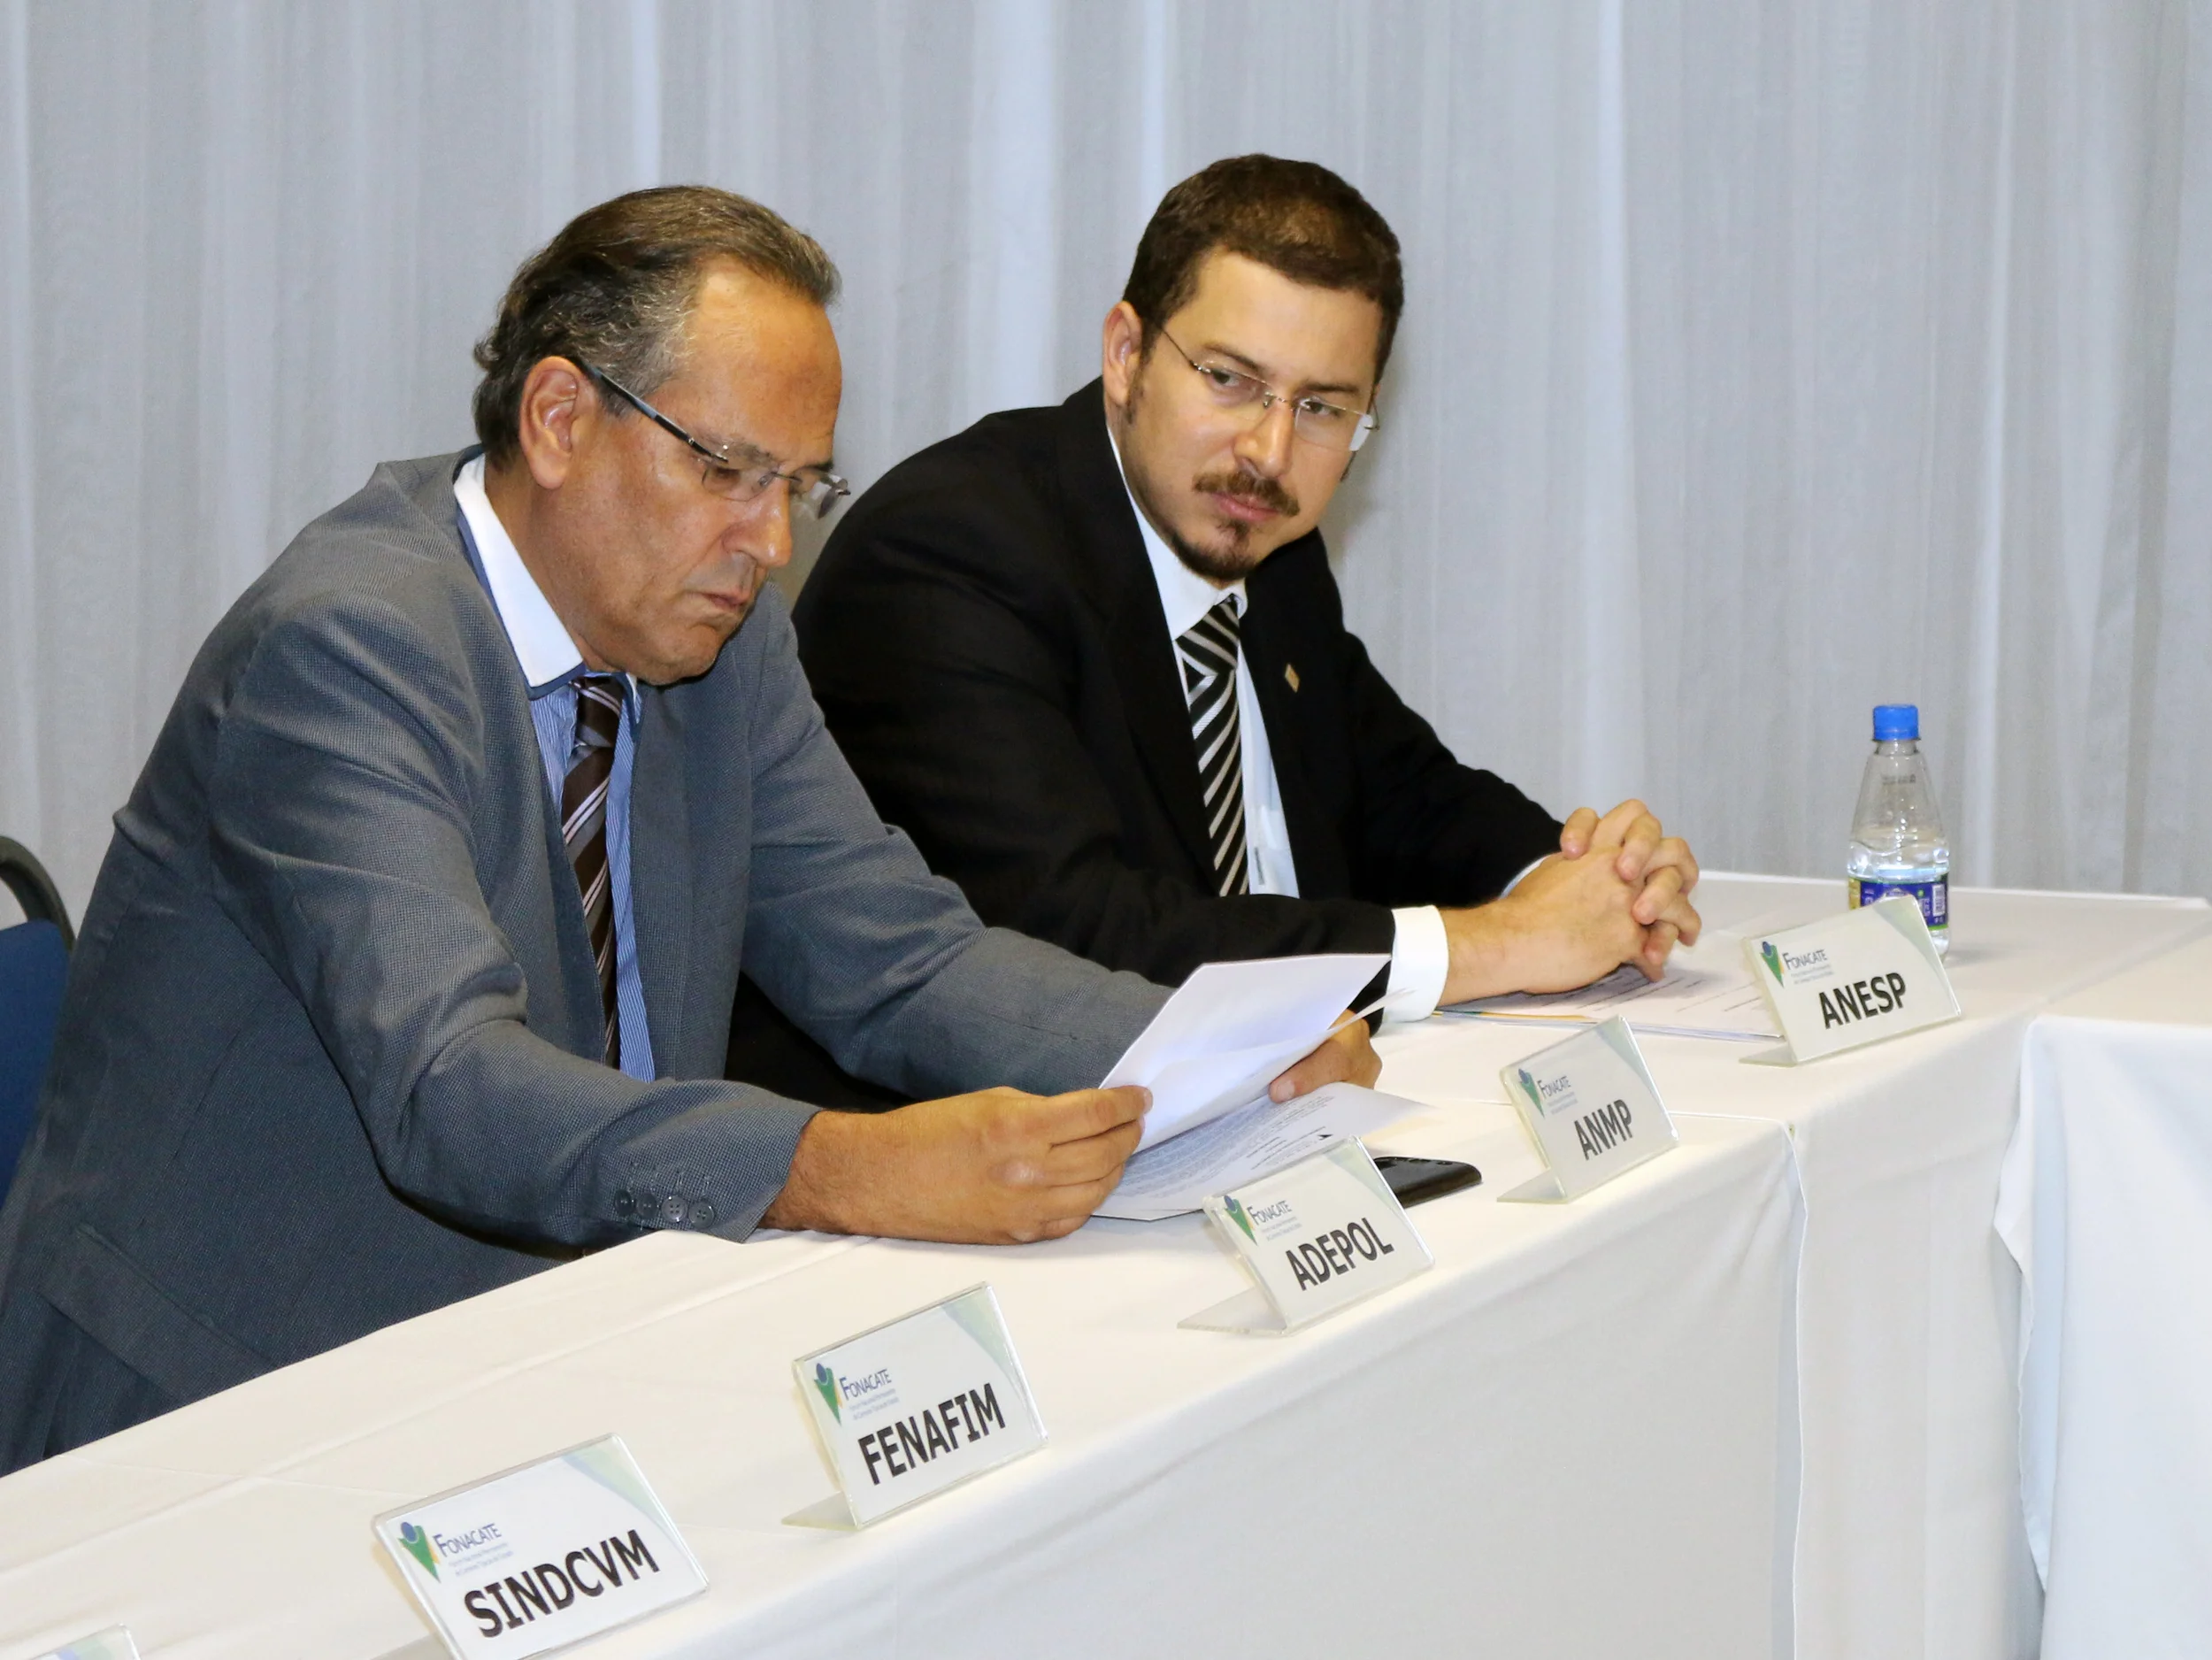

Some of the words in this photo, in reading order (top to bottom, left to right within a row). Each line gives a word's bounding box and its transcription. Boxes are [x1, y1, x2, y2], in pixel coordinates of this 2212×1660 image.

[1819, 972, 1906, 1029] ANESP
[1574, 1099, 1632, 1160] ANMP
[1286, 1217, 1394, 1291] ADEPOL
[839, 1368, 892, 1401] FONACATE
[858, 1382, 1006, 1486] FENAFIM
[432, 1523, 502, 1557] FONACATE
[465, 1529, 661, 1638] SINDCVM
